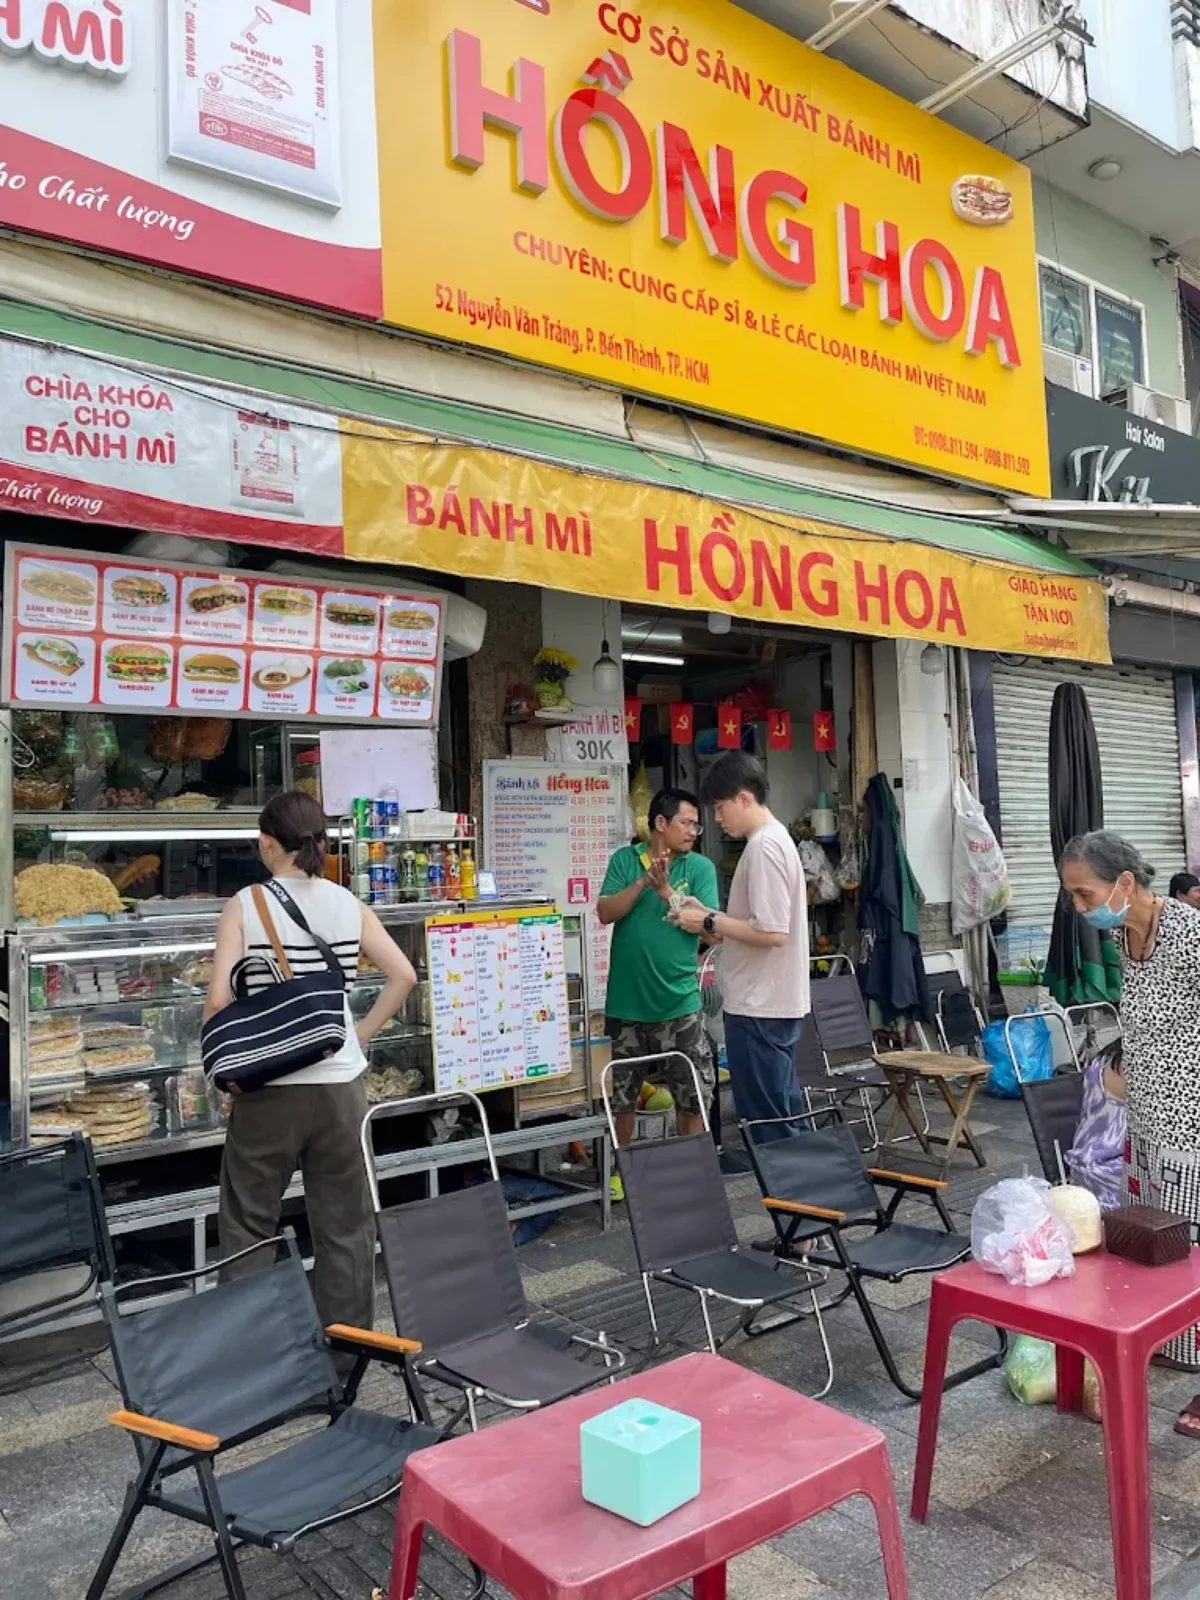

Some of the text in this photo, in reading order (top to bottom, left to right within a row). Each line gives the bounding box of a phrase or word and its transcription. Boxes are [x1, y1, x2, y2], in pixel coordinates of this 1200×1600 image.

[42, 0, 123, 65] MÌ
[598, 2, 922, 184] CƠ SỞ SẢN XUẤT BÁNH MÌ
[38, 176, 109, 212] Chất
[117, 196, 195, 240] lượng
[449, 28, 1021, 370] HỒNG HOA
[436, 283, 710, 385] 52 Nguyễn Văn Tráng, P. Bến Thành, TP. HCM
[513, 230, 613, 283] CHUYÊN:
[618, 267, 677, 303] CUNG
[681, 288, 719, 316] CẤP
[745, 310, 757, 331] &
[762, 313, 781, 338] LẺ
[785, 324, 818, 351] CÁC
[821, 336, 857, 365] LOẠI
[860, 350, 901, 379] BÁNH
[906, 364, 922, 386] MÌ
[924, 371, 953, 396] VIỆT
[956, 382, 987, 406] NAM
[25, 373, 174, 411] CHÌA KHÓA
[74, 406, 130, 429] CHO
[1125, 420, 1165, 452] Hair Salon
[25, 421, 175, 465] BÁNH MÌ
[47, 487, 103, 515] lượng
[406, 484, 967, 637] BÁNH MÌ HỒNG HOA
[1008, 575, 1078, 601] GIAO HÀNG
[1023, 602, 1074, 626] TẬN NƠI
[576, 740, 614, 760] 30K
[585, 777, 610, 791] Hoa
